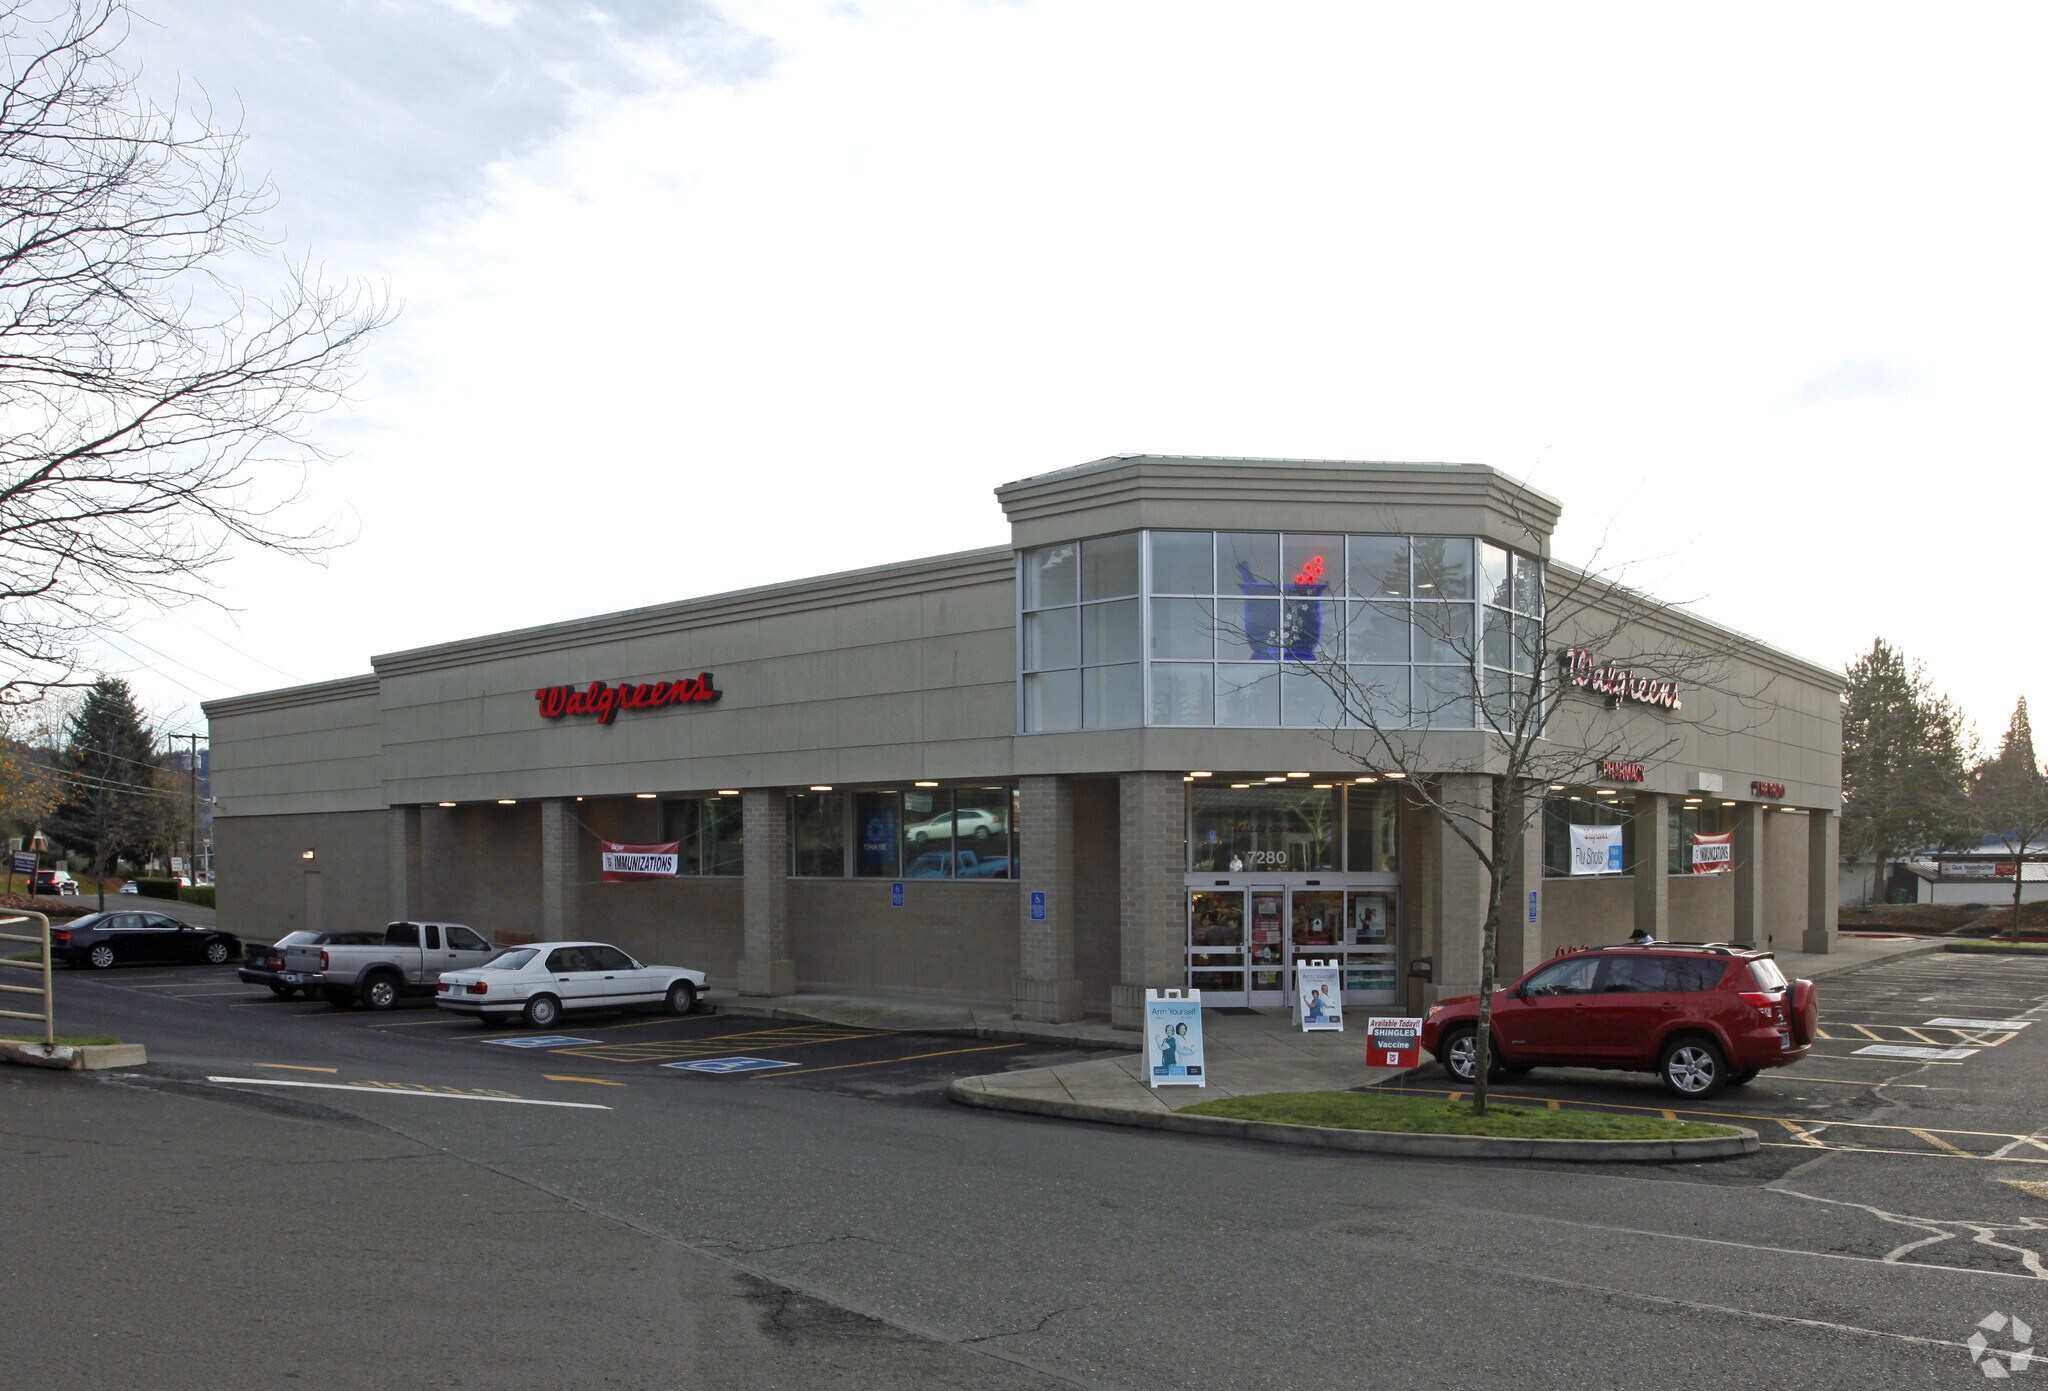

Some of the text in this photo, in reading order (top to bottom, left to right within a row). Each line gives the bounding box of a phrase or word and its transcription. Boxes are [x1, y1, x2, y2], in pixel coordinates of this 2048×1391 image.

[1565, 648, 1682, 710] Walgreens
[535, 671, 717, 724] Walgreens
[614, 855, 672, 872] IMMUNIZATIONS
[1248, 851, 1287, 864] 7280
[1576, 847, 1586, 865] Flu
[1586, 847, 1604, 865] Shots
[1168, 1008, 1196, 1016] Yourself
[1399, 1020, 1421, 1028] Today!!
[1373, 1029, 1416, 1037] SHINGLES
